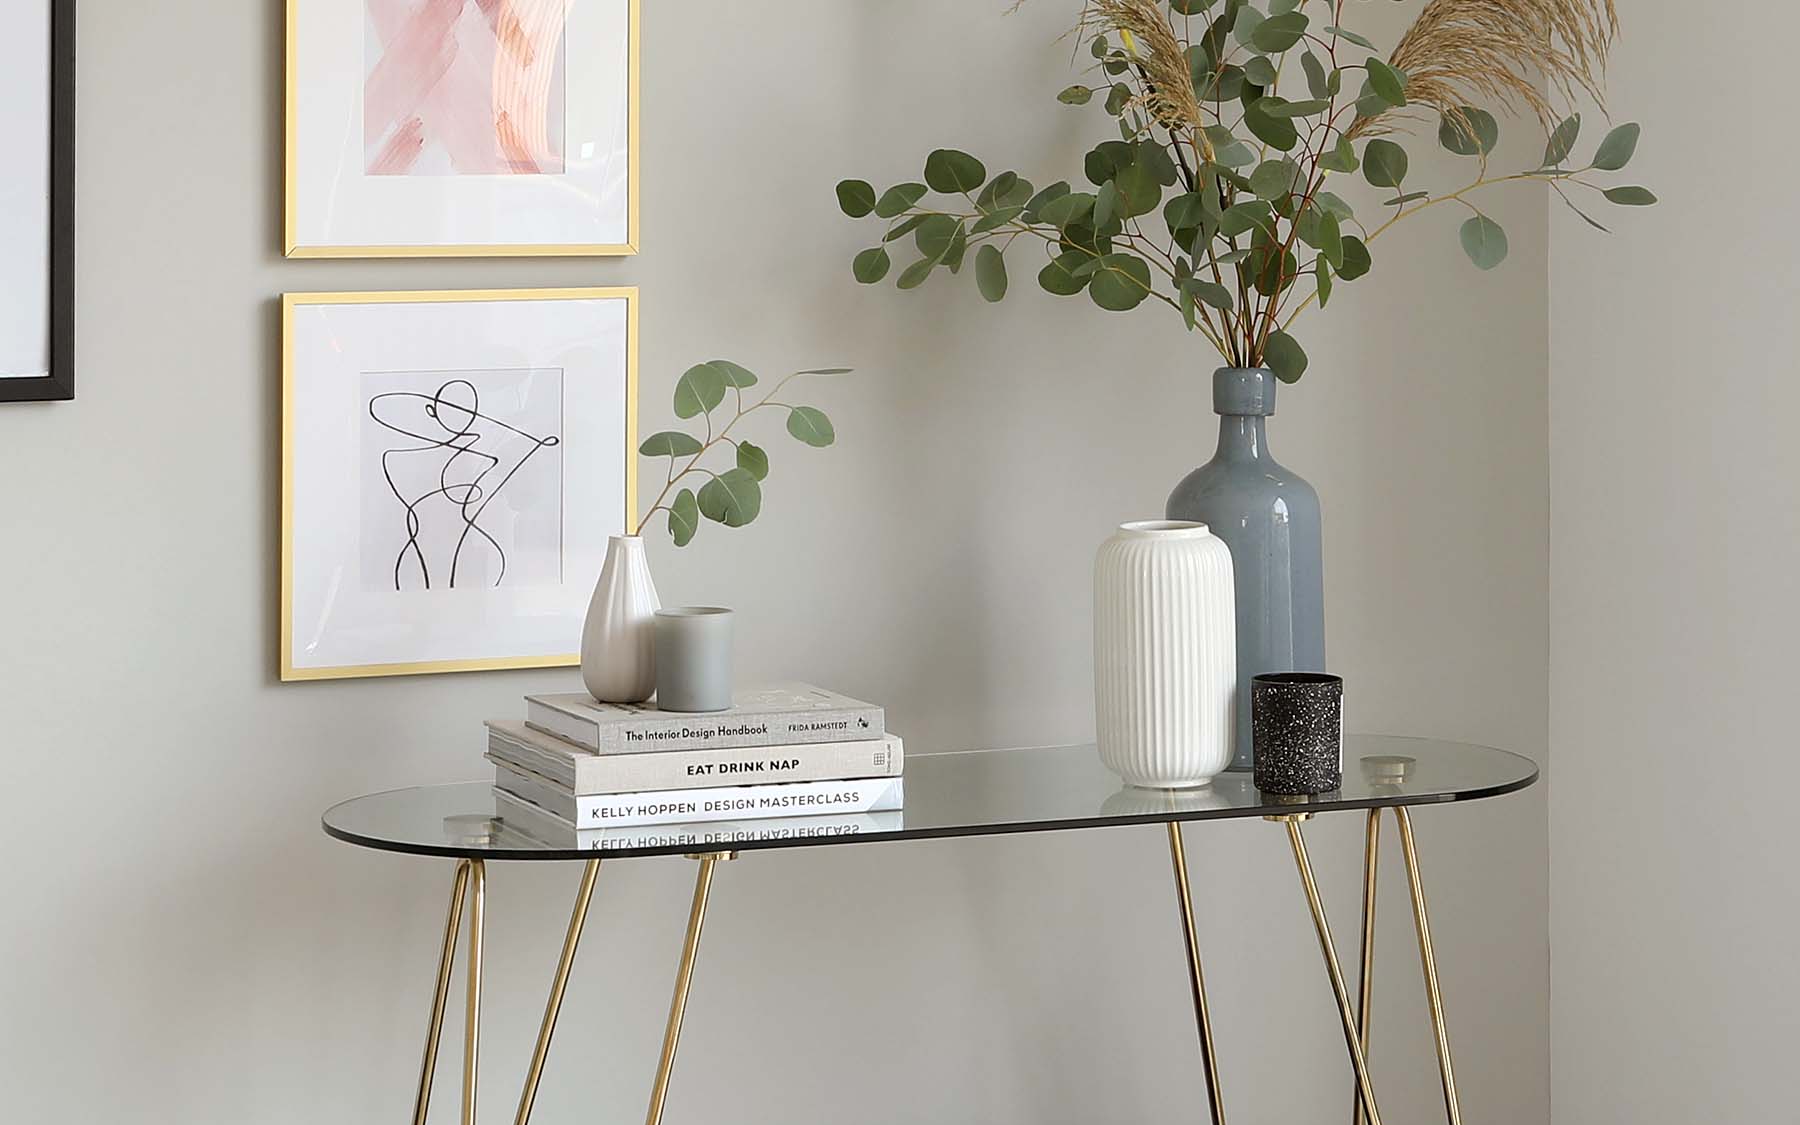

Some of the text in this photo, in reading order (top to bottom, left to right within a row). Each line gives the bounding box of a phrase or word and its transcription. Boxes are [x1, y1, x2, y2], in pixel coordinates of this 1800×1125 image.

[626, 723, 767, 741] The Interior Design Handbook
[788, 722, 847, 732] FRIDA RAMSTEDT
[687, 759, 799, 775] EAT DRINK NAP
[592, 791, 860, 818] KELLY HOPPEN DESIGN MASTERCLASS
